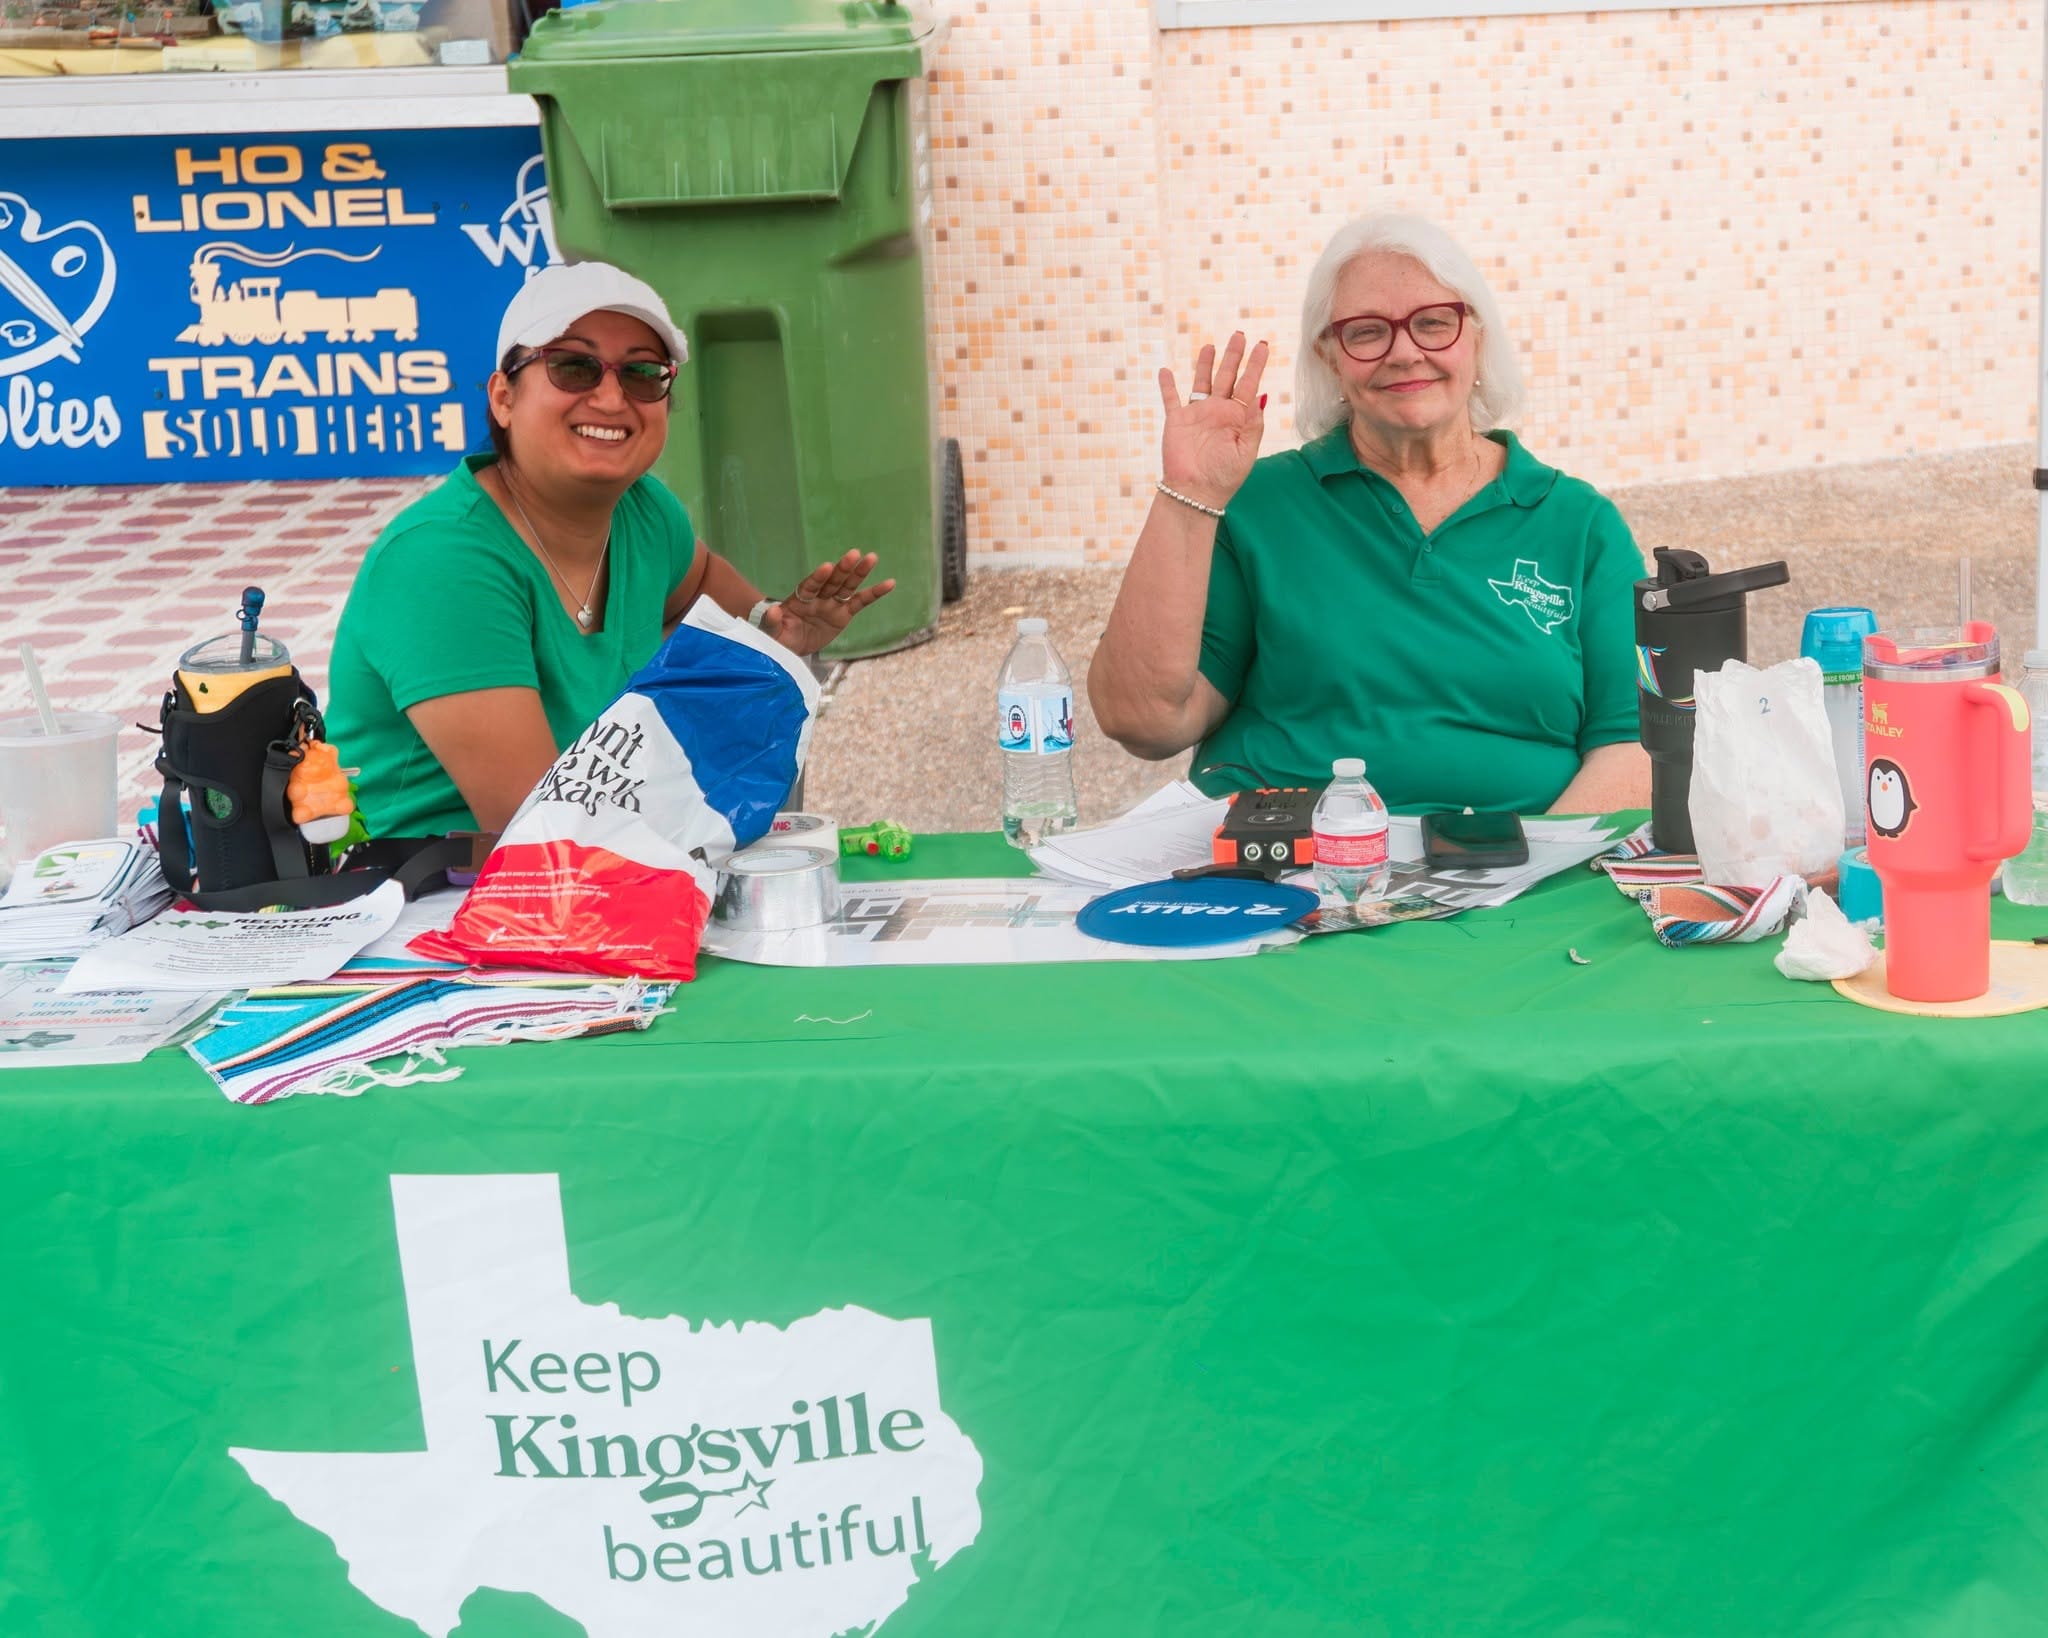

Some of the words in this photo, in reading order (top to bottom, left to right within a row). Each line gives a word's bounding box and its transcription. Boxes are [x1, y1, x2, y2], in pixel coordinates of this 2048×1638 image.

[176, 145, 301, 186] HO
[322, 143, 386, 182] &
[132, 188, 437, 233] LIONEL
[148, 350, 451, 400] TRAINS
[152, 405, 306, 458] SOLD
[316, 403, 452, 455] HERE
[1759, 697, 1771, 714] 2
[233, 912, 362, 924] RECYCLING
[241, 922, 333, 930] CENTER
[1108, 903, 1240, 915] RALLY
[482, 1338, 662, 1408] Keep
[485, 1392, 926, 1528] Kingsville
[603, 1496, 930, 1583] beautiful
